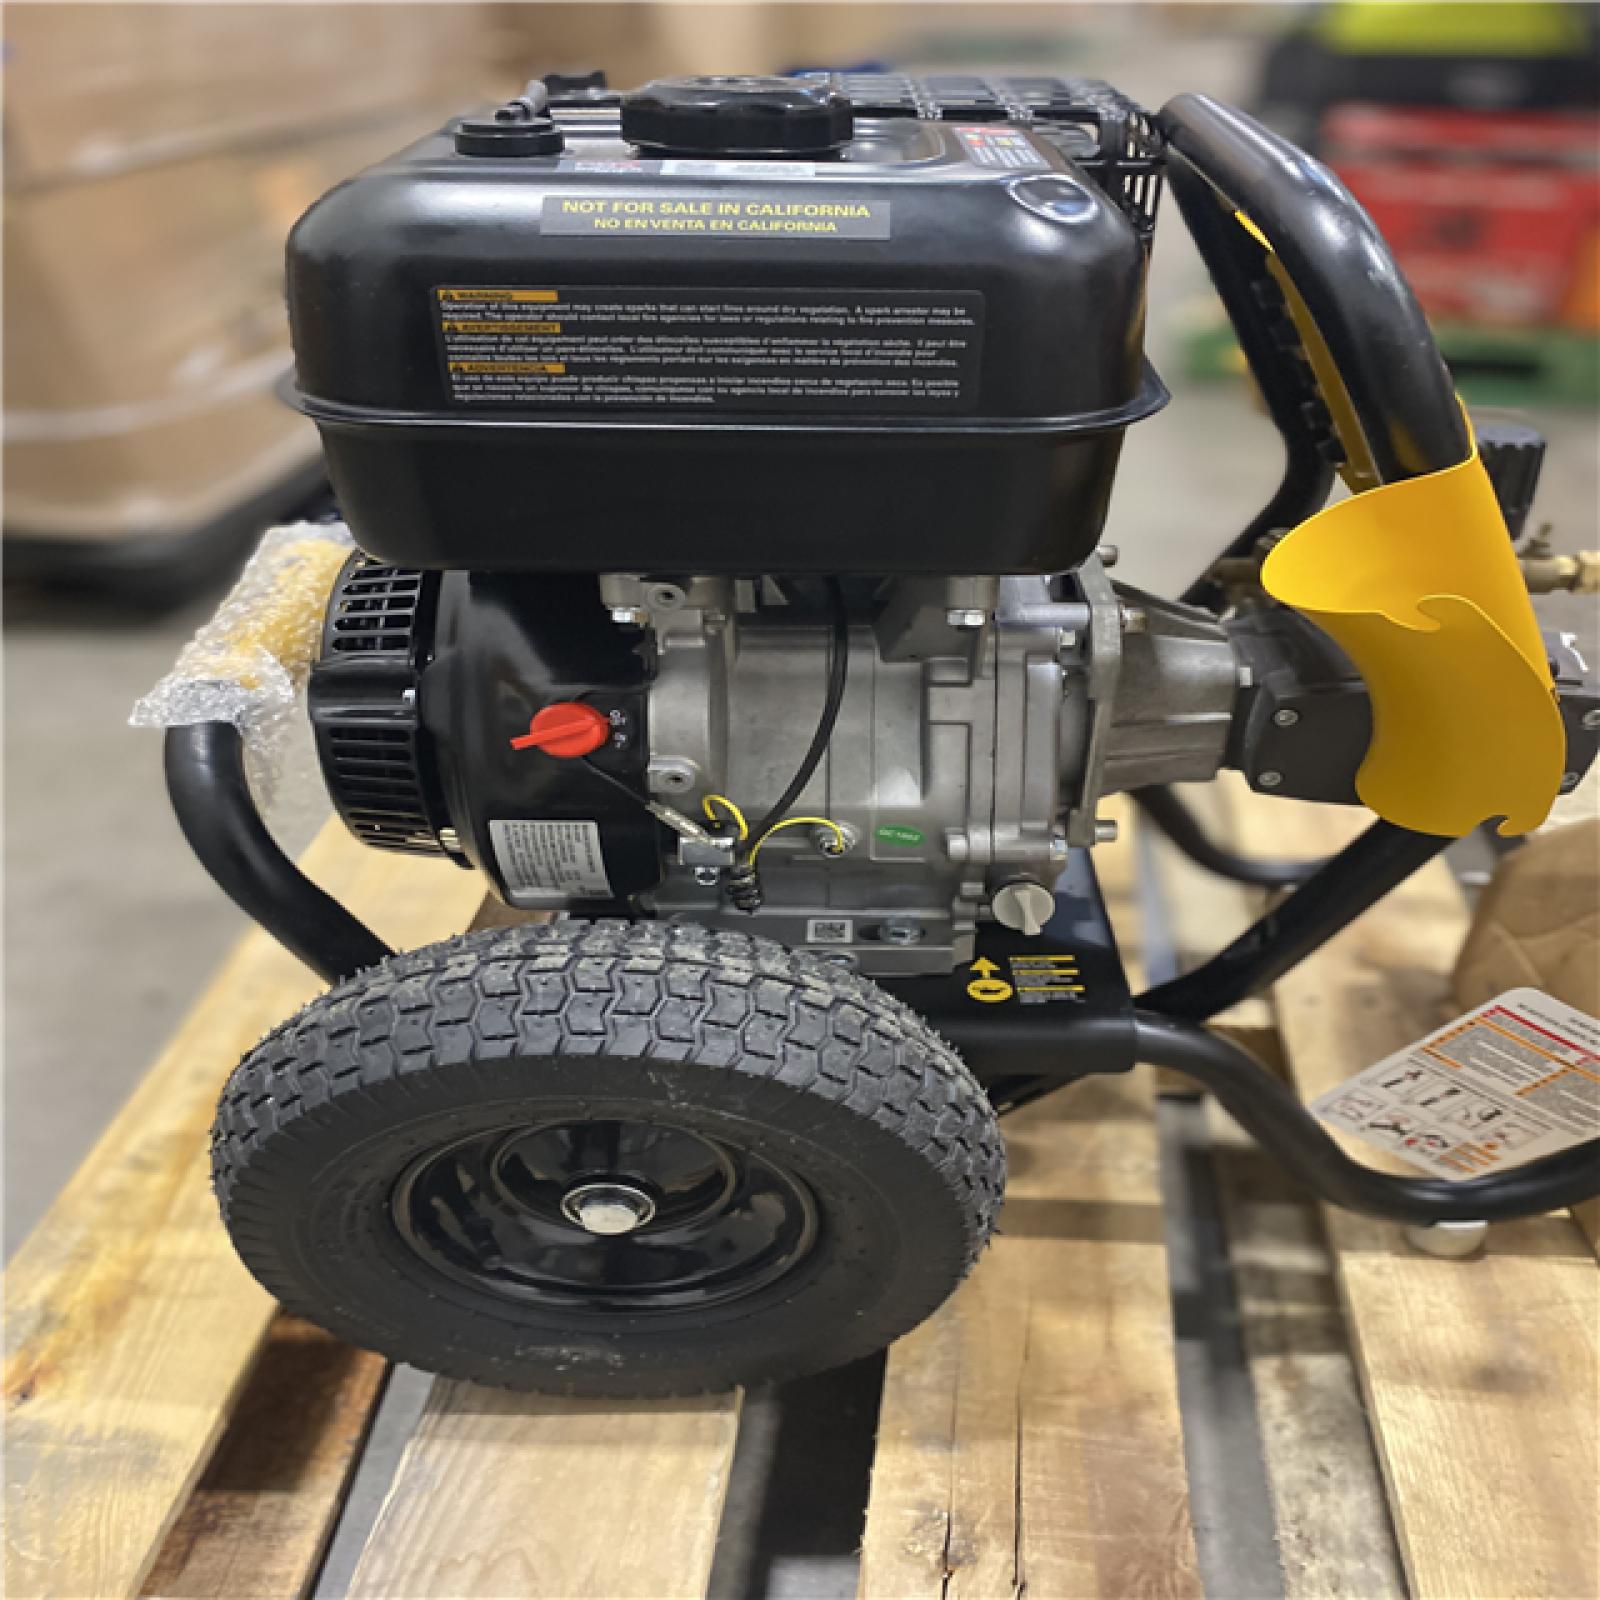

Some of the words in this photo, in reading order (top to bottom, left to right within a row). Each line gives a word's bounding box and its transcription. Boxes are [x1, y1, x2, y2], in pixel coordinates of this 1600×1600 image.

[562, 199, 608, 213] NOT
[612, 200, 655, 214] FOR
[660, 201, 712, 216] SALE
[719, 202, 740, 216] IN
[746, 203, 871, 218] CALIFORNIA
[594, 218, 621, 229] NO
[624, 219, 648, 230] EN
[650, 219, 706, 231] VENTA
[710, 220, 733, 231] EN
[737, 220, 838, 232] CALIFORNIA
